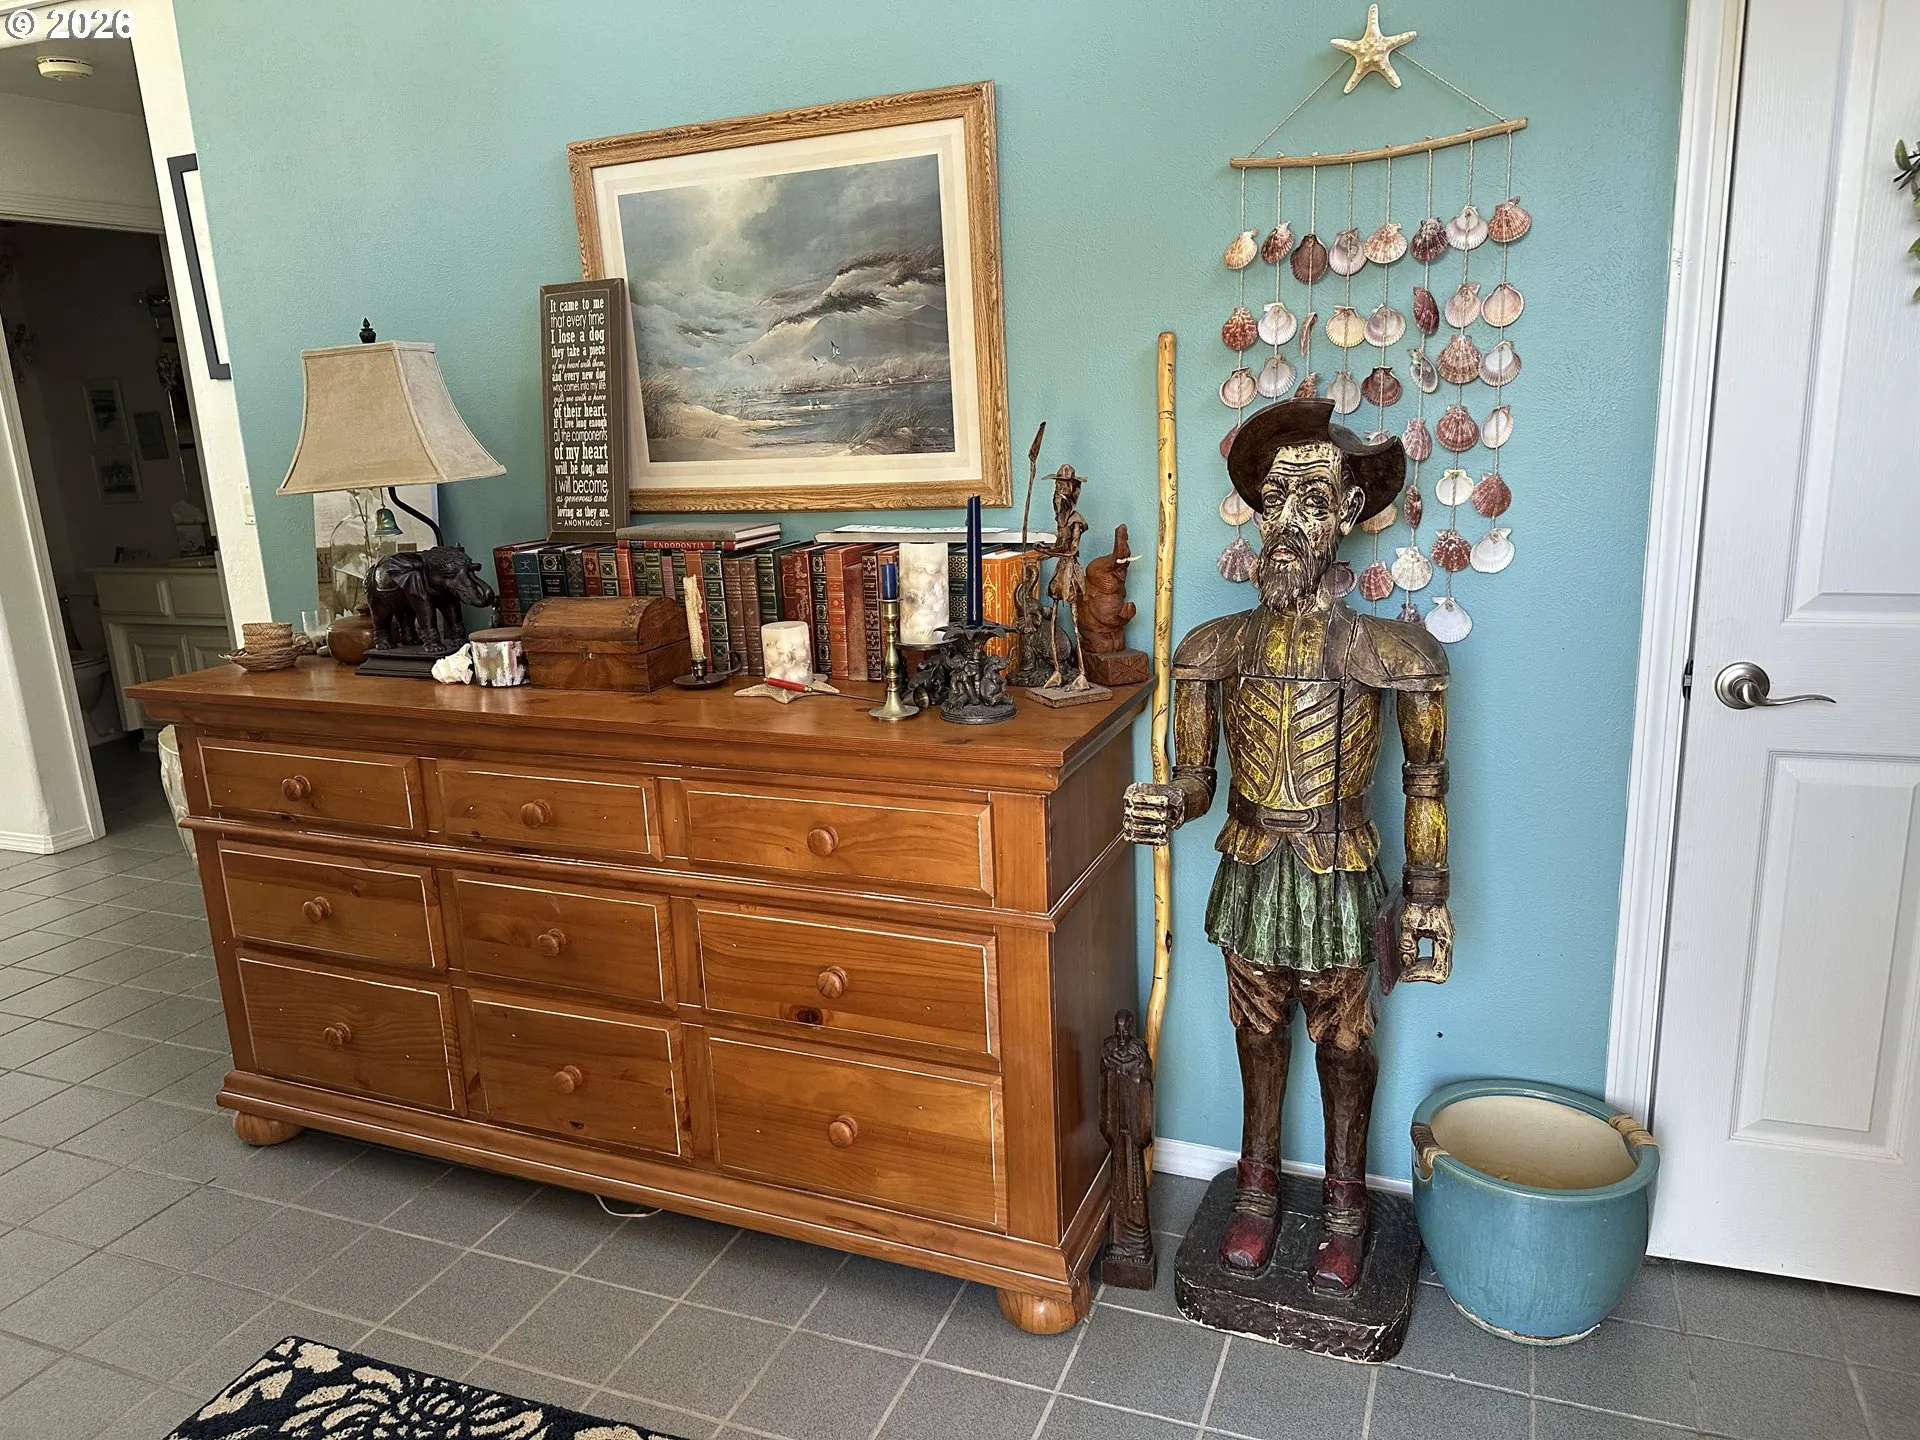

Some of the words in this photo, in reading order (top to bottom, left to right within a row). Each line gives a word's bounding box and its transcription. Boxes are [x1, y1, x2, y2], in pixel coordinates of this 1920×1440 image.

[550, 300, 556, 312] It
[560, 300, 578, 312] came
[582, 298, 590, 310] to
[593, 298, 604, 309] me
[550, 312, 565, 328] that
[566, 314, 587, 330] every
[588, 310, 604, 326] time
[551, 329, 555, 344] I
[558, 329, 575, 344] lose
[580, 331, 585, 342] a
[589, 326, 605, 344] dog
[551, 345, 564, 360] they
[566, 344, 580, 357] take
[583, 346, 587, 356] a
[589, 343, 606, 359] piece
[558, 364, 566, 374] my
[567, 358, 580, 368] heart
[580, 360, 591, 368] with
[552, 370, 562, 382] and
[564, 372, 580, 383] every
[582, 371, 594, 380] new
[596, 368, 606, 382] dog
[552, 384, 562, 392] who
[564, 383, 580, 392] comes
[580, 382, 589, 390] into
[590, 382, 598, 392] my
[598, 380, 606, 390] life
[553, 392, 565, 407] gifts
[574, 391, 587, 402] with
[592, 392, 606, 405] piece
[554, 404, 562, 418] of
[563, 403, 582, 418] their
[584, 402, 607, 417] heart.
[553, 418, 559, 428] If
[564, 418, 574, 428] live
[576, 418, 587, 430] long
[589, 417, 608, 430] enough
[561, 429, 570, 442] the
[572, 430, 608, 444] components
[554, 442, 564, 460] of
[566, 446, 580, 464] my
[582, 441, 608, 460] heart
[555, 461, 568, 474] will
[570, 461, 578, 474] be
[581, 461, 595, 477] dog,
[596, 461, 609, 474] and
[555, 476, 558, 493] I
[558, 476, 571, 494] will
[572, 476, 609, 496] become,
[564, 495, 592, 508] generous
[557, 506, 574, 520] loving
[576, 508, 583, 517] as
[584, 505, 597, 520] they
[599, 508, 610, 517] are.
[564, 519, 603, 527] ANONYMOUS
